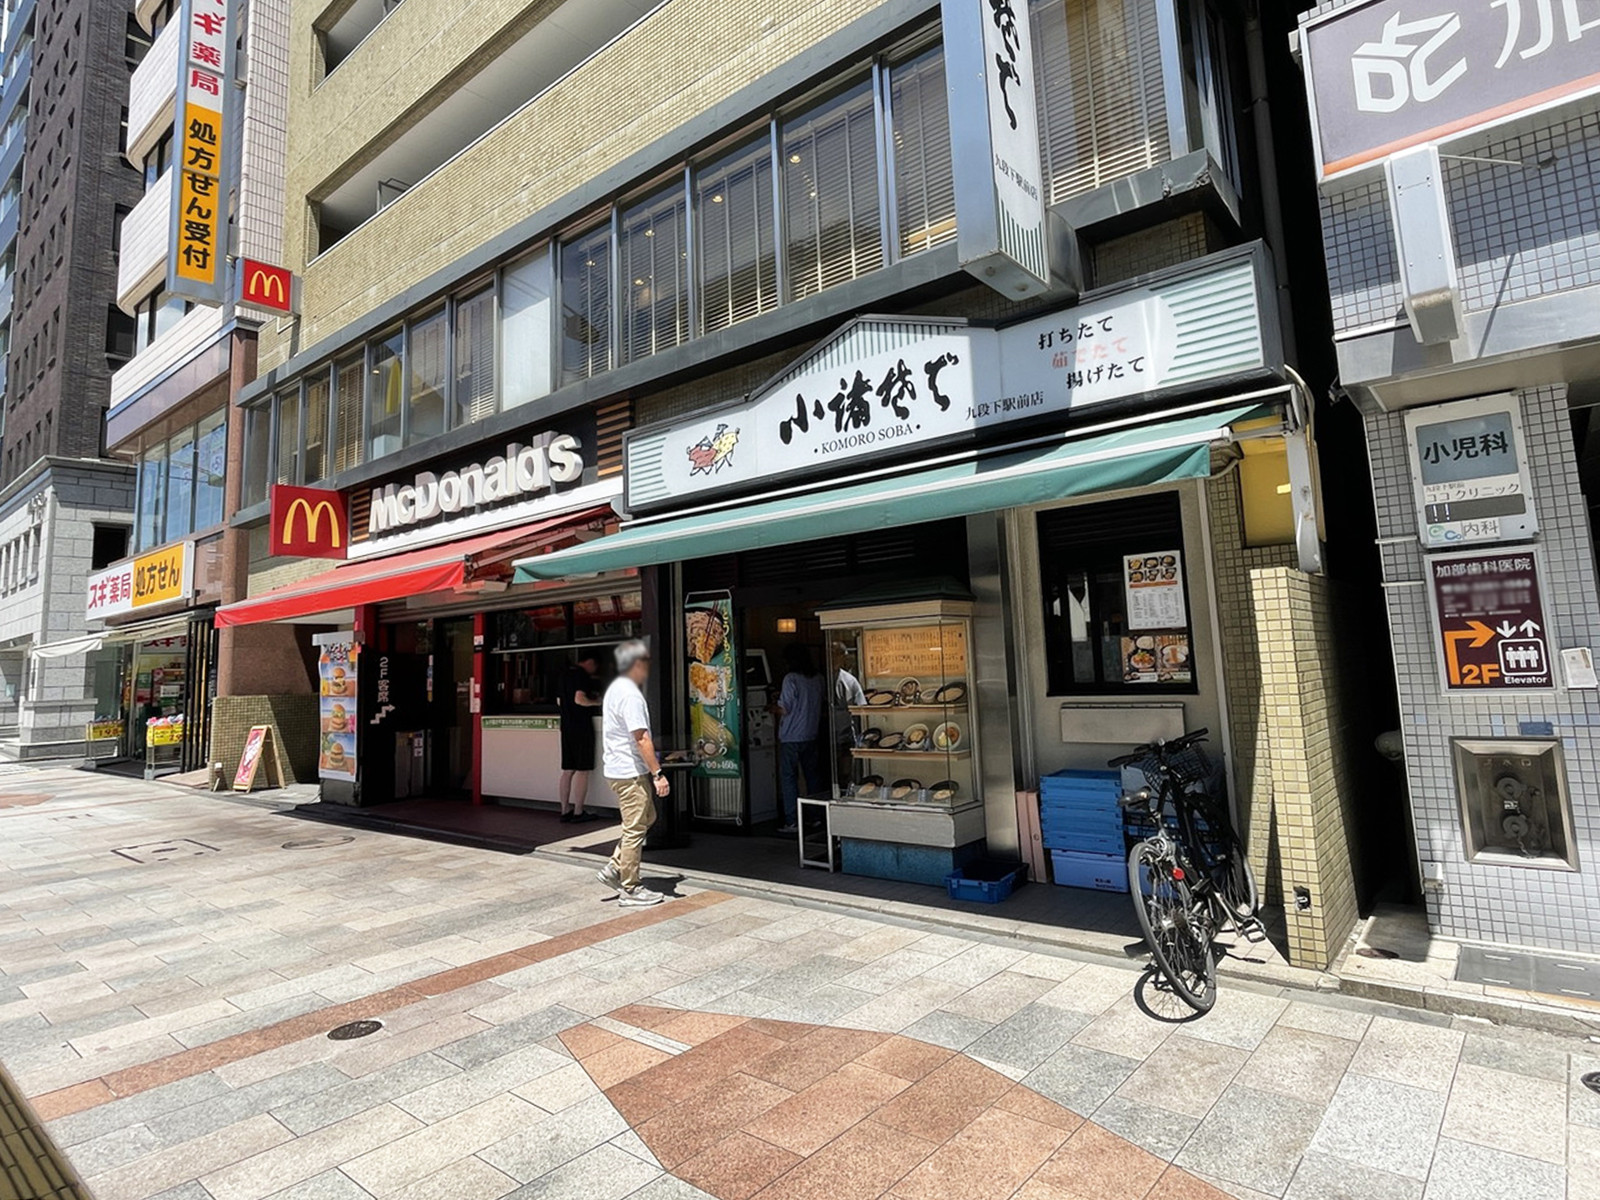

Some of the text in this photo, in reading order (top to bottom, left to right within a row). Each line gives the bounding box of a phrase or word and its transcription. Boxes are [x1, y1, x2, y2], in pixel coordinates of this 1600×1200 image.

[183, 118, 217, 270] 処方せん受付
[995, 153, 1038, 201] 九段下駅前店
[1038, 315, 1114, 350] 打ちたて
[1066, 356, 1145, 390] 揚げたて
[965, 391, 1044, 421] 九段下駅前店
[822, 423, 914, 455] KOMORO SOBA
[1423, 430, 1509, 465] 小児科
[368, 430, 583, 533] McDonald's
[1463, 519, 1499, 537] 内科
[135, 556, 180, 598] 処方せん
[1435, 557, 1532, 578] 加部歯科医院
[88, 572, 131, 610] スギ薬局
[1461, 663, 1500, 685] 2F
[1504, 675, 1548, 685] Elevator
